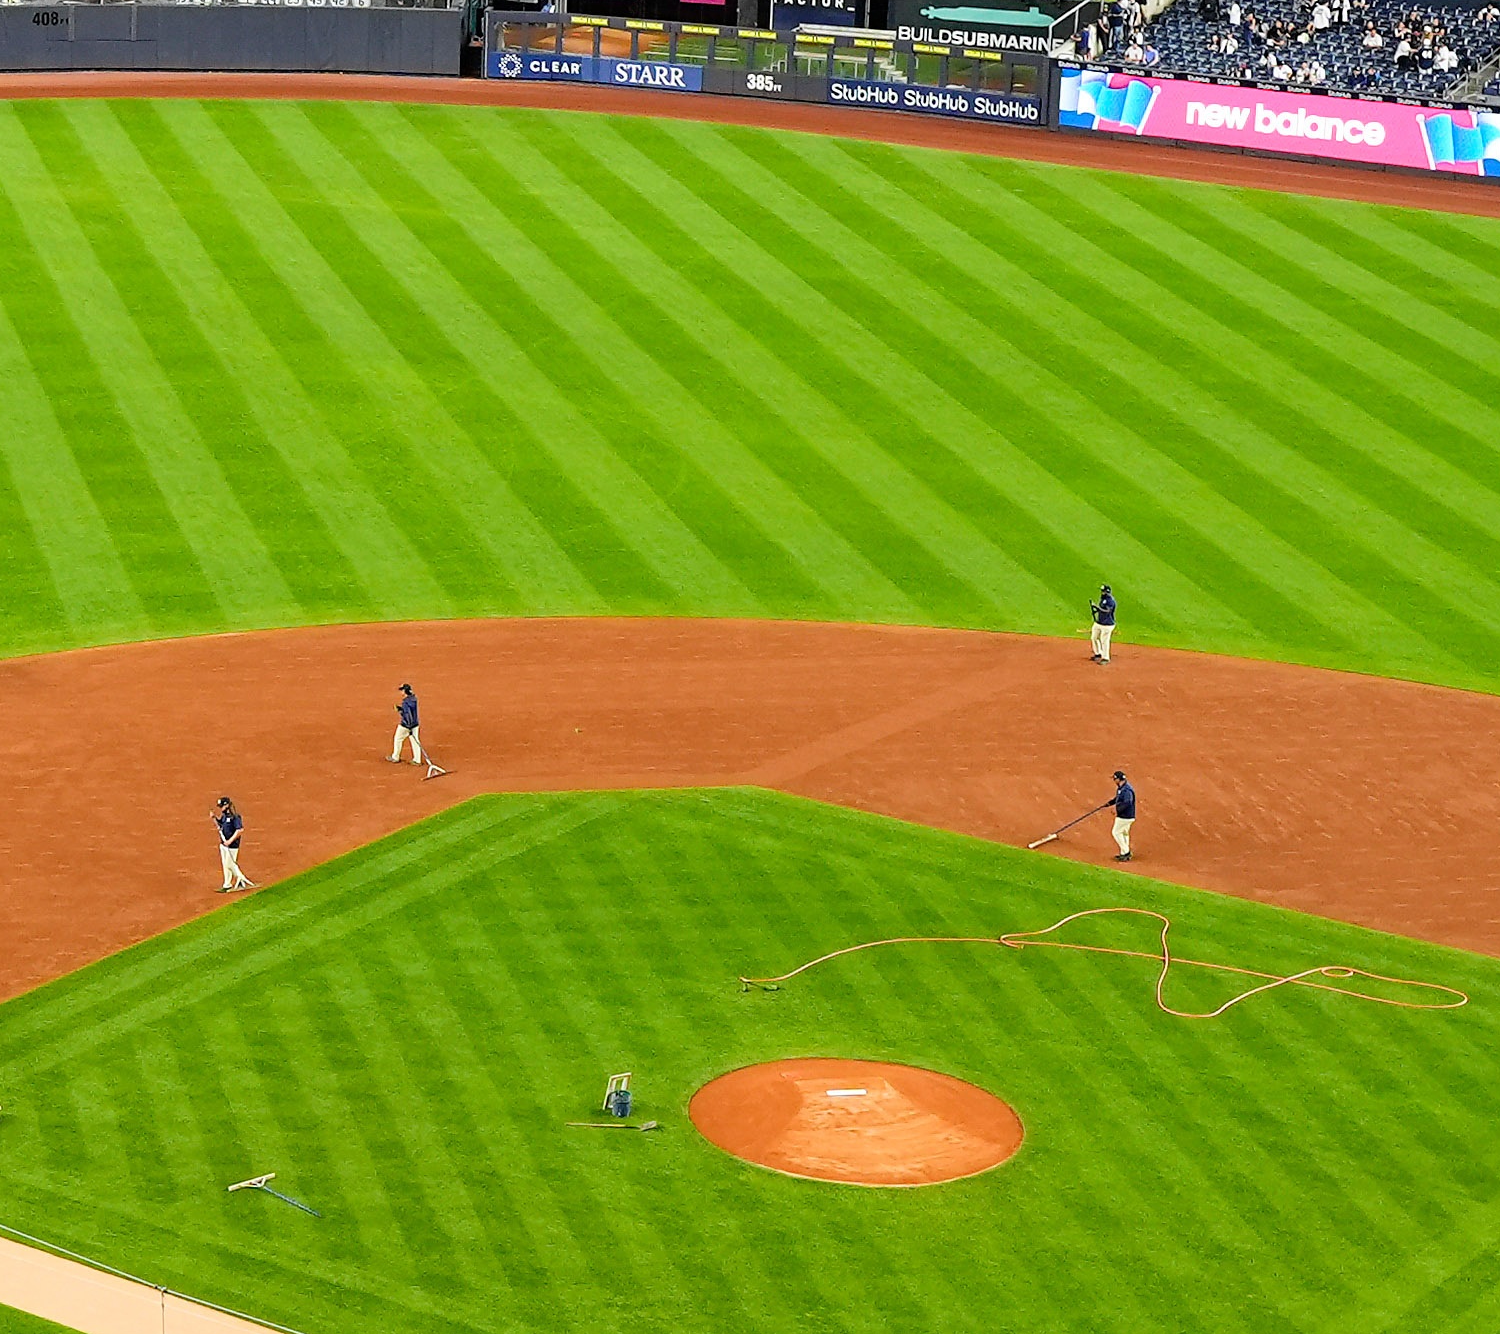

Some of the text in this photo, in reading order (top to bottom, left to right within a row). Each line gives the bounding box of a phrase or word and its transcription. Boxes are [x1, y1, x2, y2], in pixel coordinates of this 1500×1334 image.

[530, 60, 580, 75] CLEAR
[615, 63, 686, 88] STARR
[746, 73, 773, 92] 385
[831, 82, 1038, 121] StubHub StubHub StubHub
[1186, 101, 1385, 146] new balance
